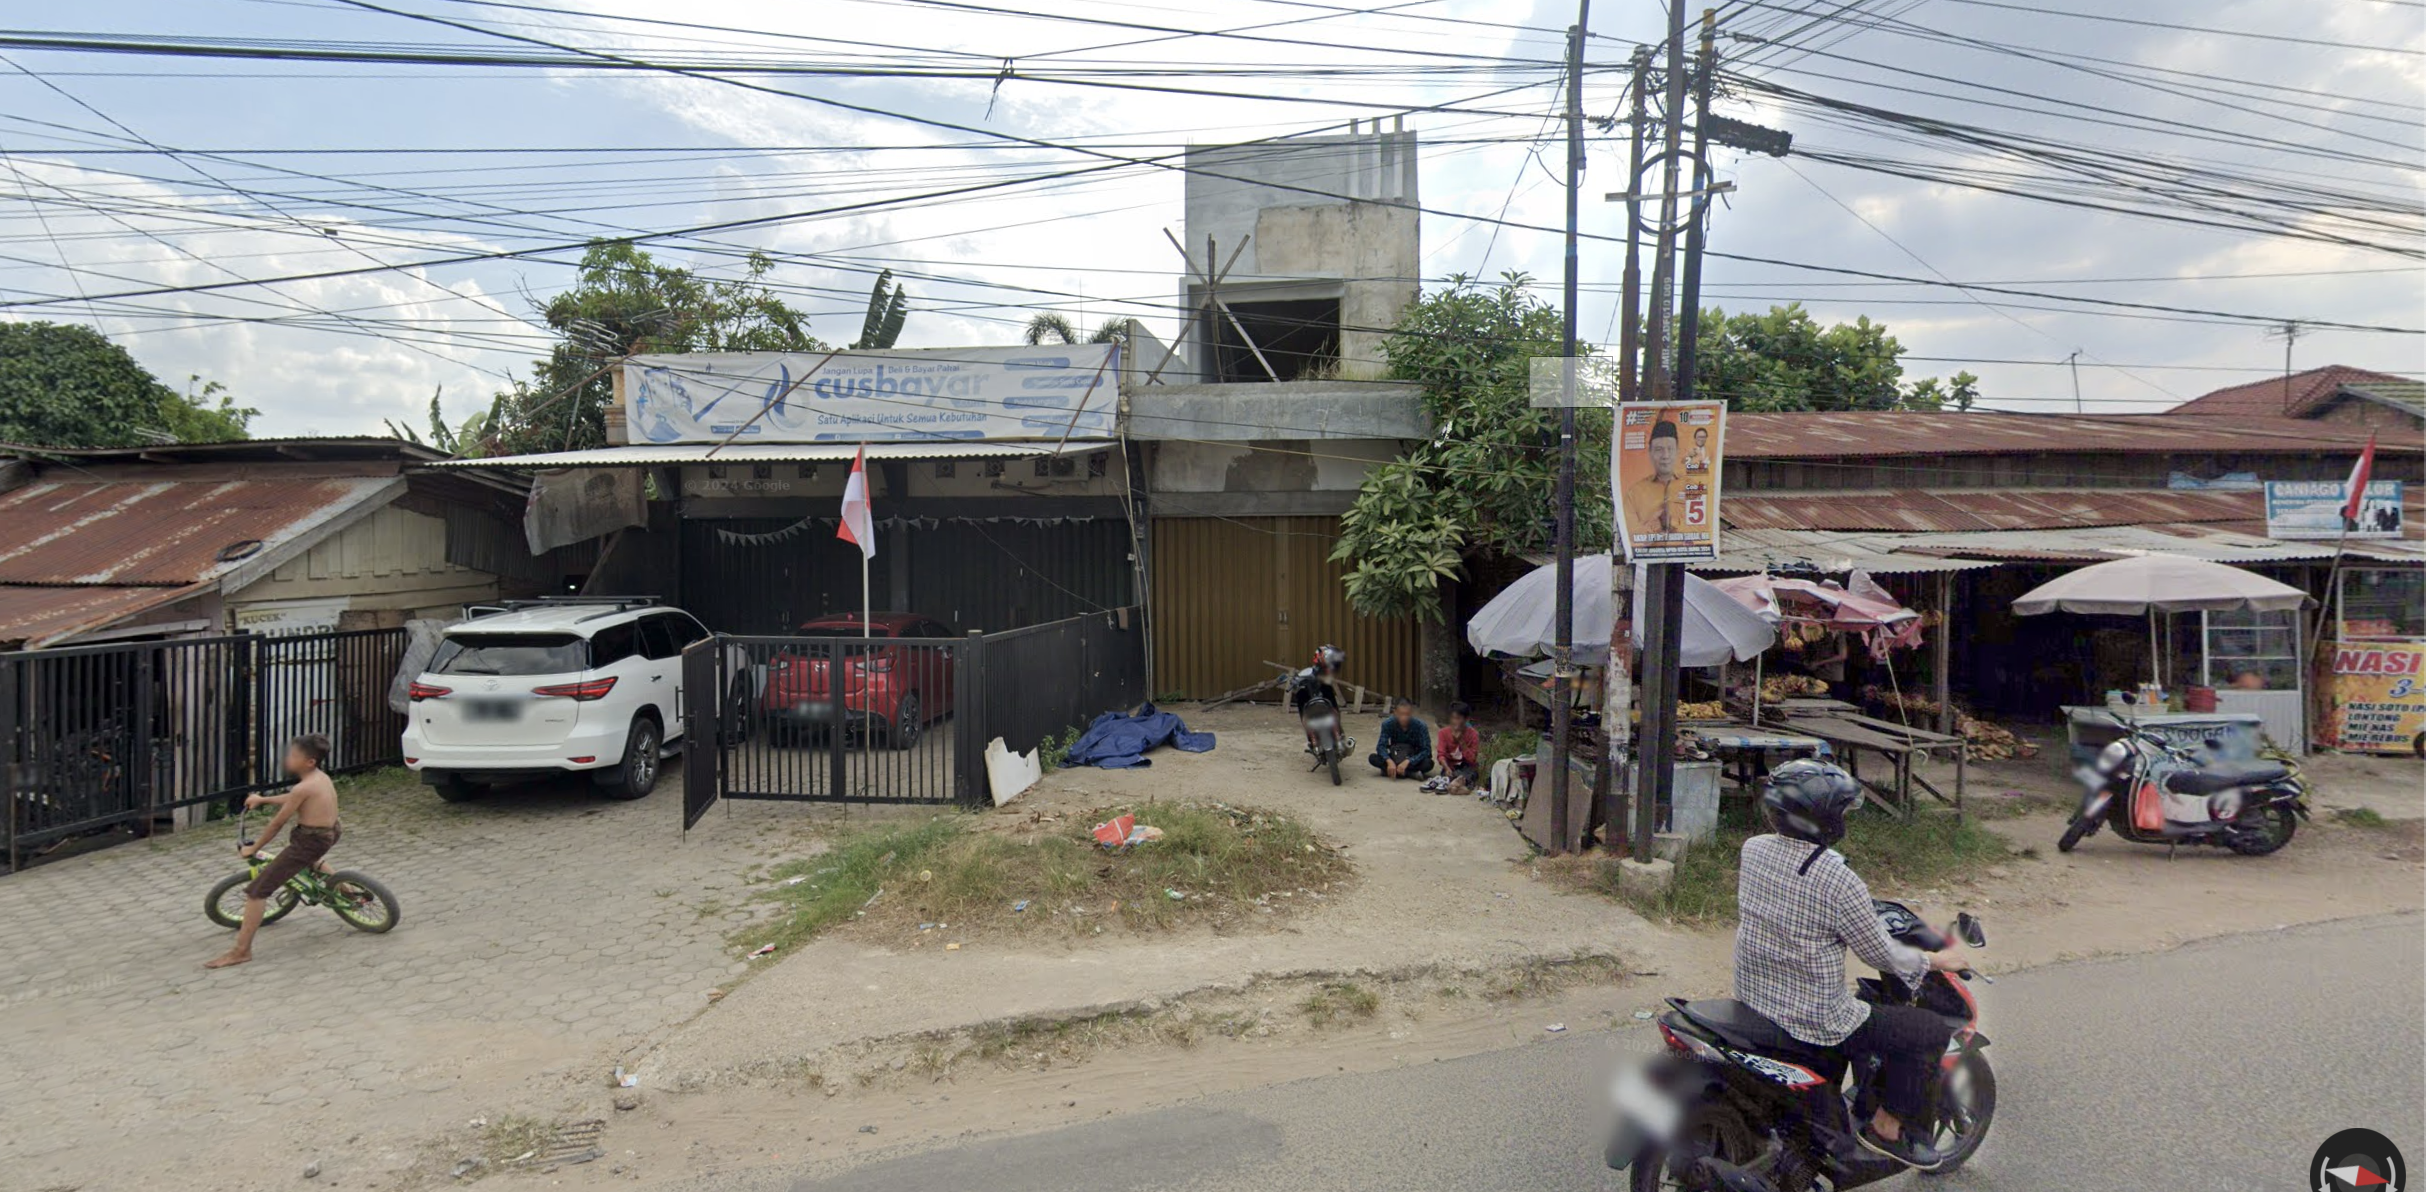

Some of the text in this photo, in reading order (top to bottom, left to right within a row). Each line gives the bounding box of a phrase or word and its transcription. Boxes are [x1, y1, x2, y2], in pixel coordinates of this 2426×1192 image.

[814, 364, 990, 408] cusbayar
[817, 411, 987, 427] Satu Aplikasi Untuk Semua Kebutuhan
[1688, 501, 1704, 524] 5
[2333, 651, 2423, 675] NASI
[2348, 703, 2376, 711] NASI
[2348, 713, 2401, 722] LONTONG
